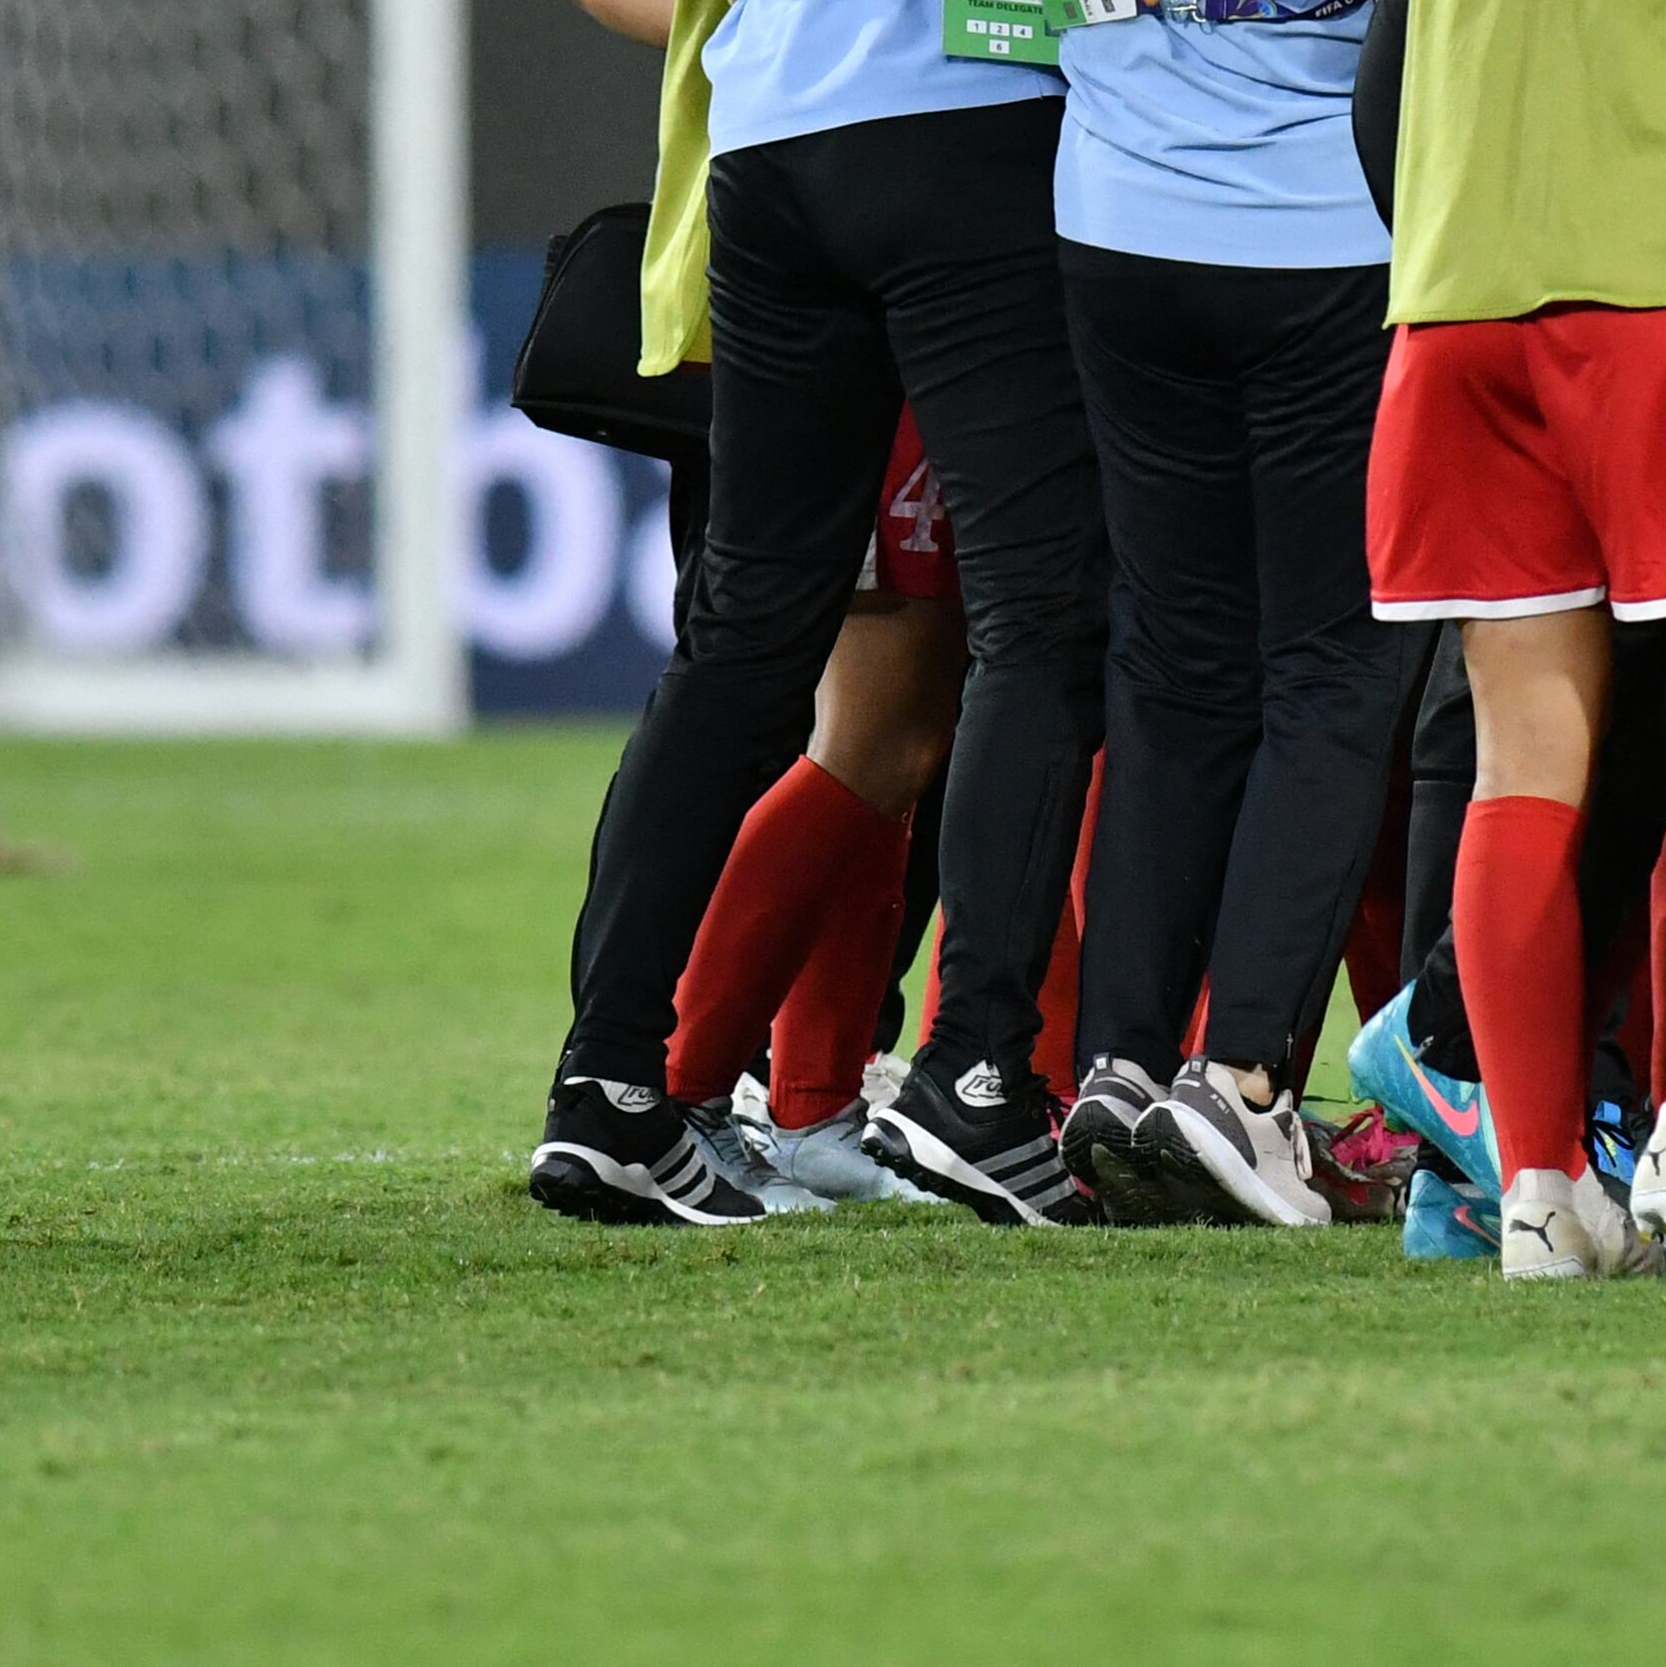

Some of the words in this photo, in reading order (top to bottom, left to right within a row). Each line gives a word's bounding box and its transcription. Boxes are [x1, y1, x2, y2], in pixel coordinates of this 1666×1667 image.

[996, 2, 1043, 15] DELEGATE
[1314, 0, 1343, 18] FIFA
[996, 25, 1003, 34] 2
[1019, 28, 1026, 37] 4
[888, 459, 945, 553] 4
